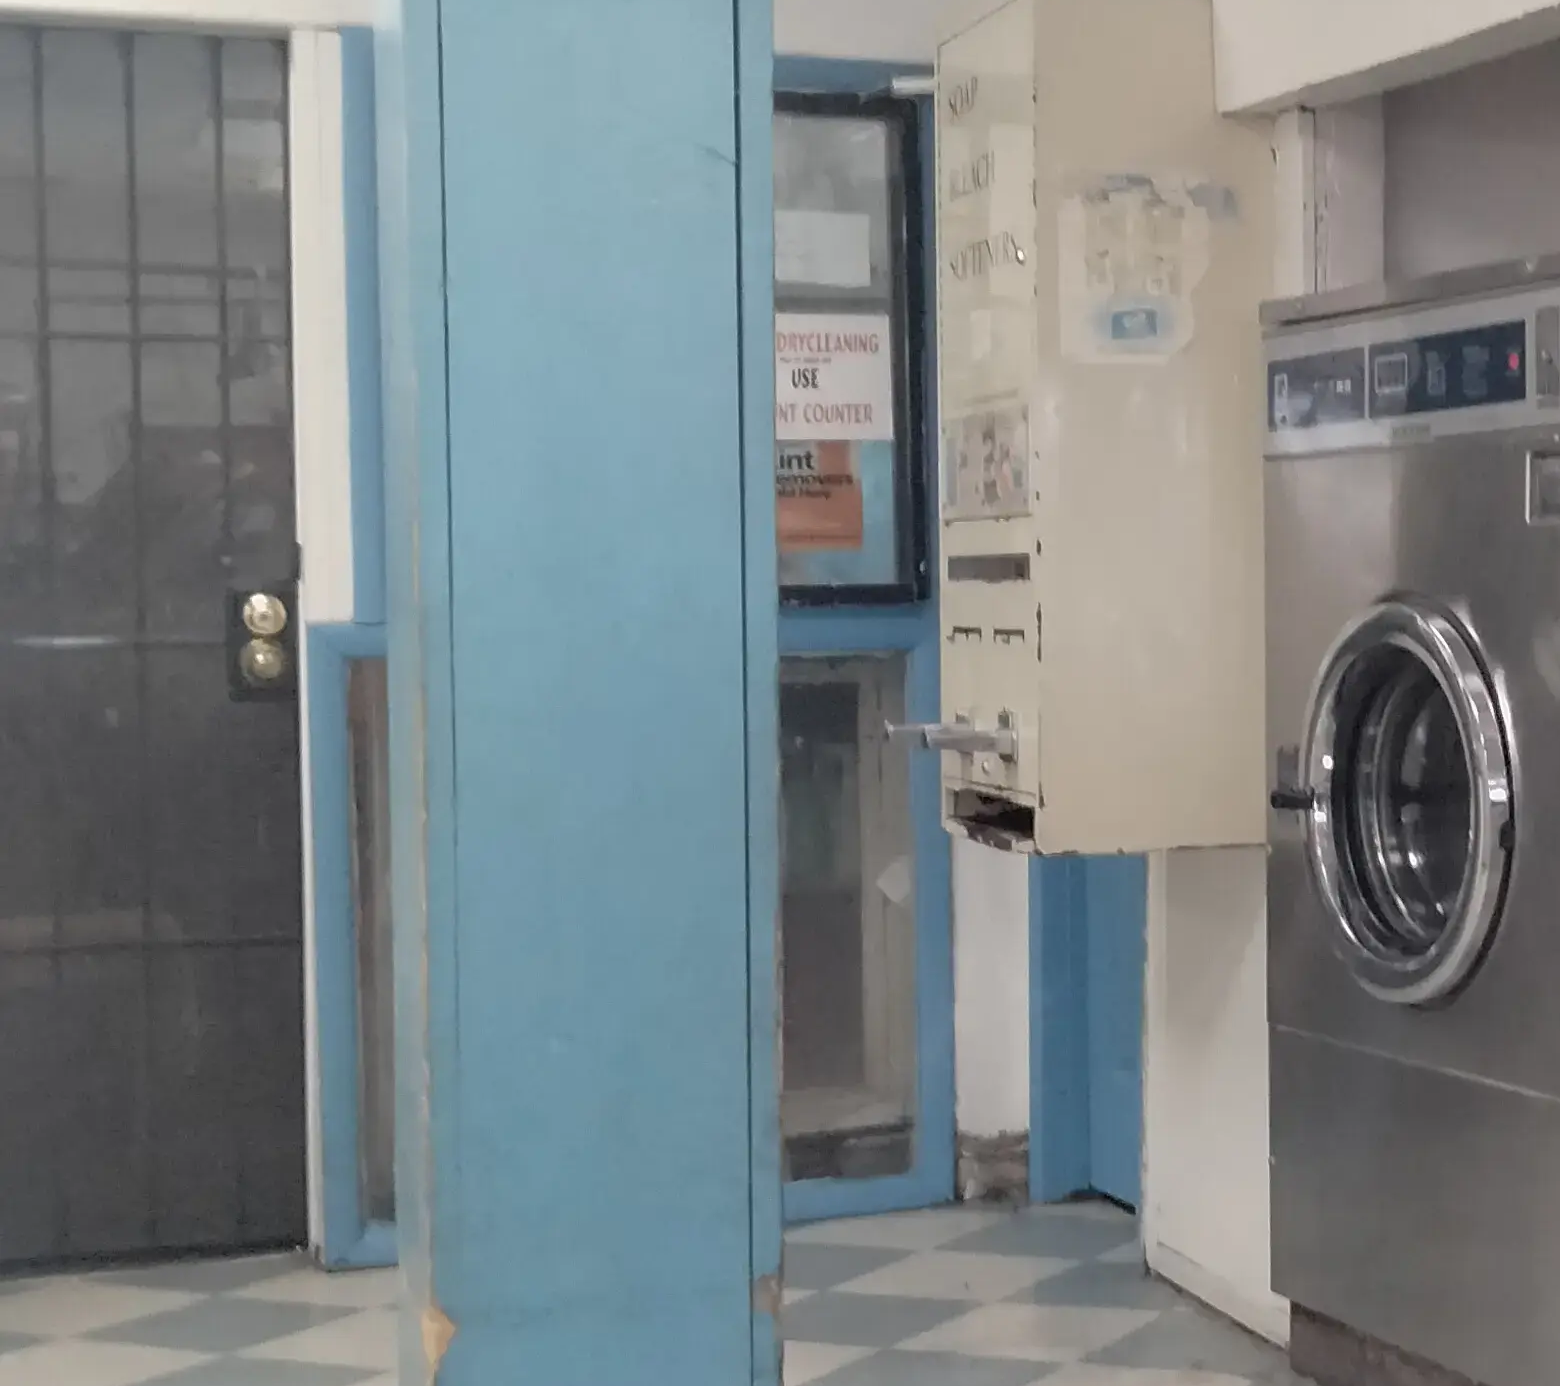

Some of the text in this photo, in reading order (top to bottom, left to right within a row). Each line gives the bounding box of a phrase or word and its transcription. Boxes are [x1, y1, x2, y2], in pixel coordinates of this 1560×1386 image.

[776, 331, 880, 354] DRYCLEANING
[791, 367, 820, 389] USE
[802, 402, 874, 425] COUNTER
